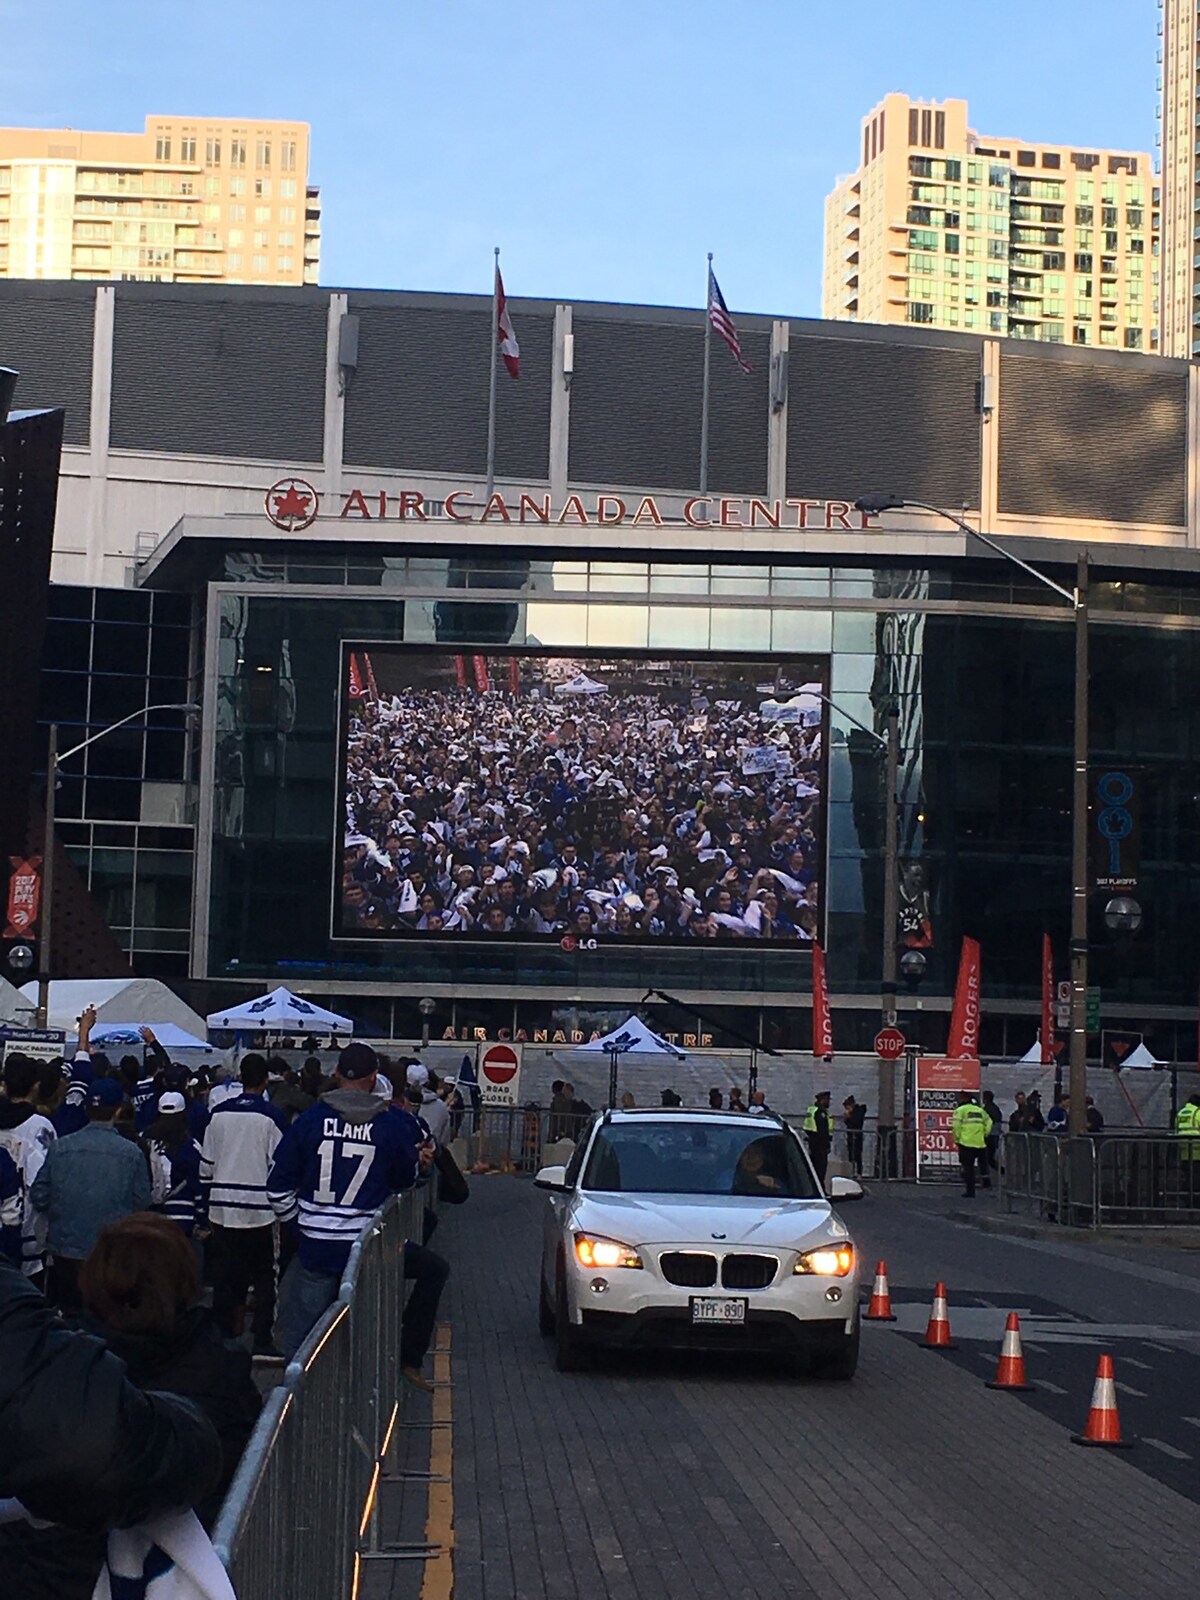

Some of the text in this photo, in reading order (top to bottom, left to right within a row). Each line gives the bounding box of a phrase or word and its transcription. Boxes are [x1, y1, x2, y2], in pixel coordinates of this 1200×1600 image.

[340, 489, 884, 531] AIR CANADA CENTRE
[903, 918, 918, 932] 54
[579, 938, 598, 950] LG
[442, 1026, 488, 1041] AIR
[497, 1027, 601, 1044] CANADA
[7, 1044, 62, 1054] PUBLIC PARKING
[877, 1038, 904, 1051] STOP
[486, 1085, 510, 1094] ROAD
[922, 1092, 956, 1100] PUBLIC
[481, 1094, 514, 1105] CLOSED
[919, 1101, 959, 1109] PARKING
[323, 1117, 374, 1141] CLARK
[313, 1140, 377, 1206] 17
[724, 1304, 744, 1318] 890
